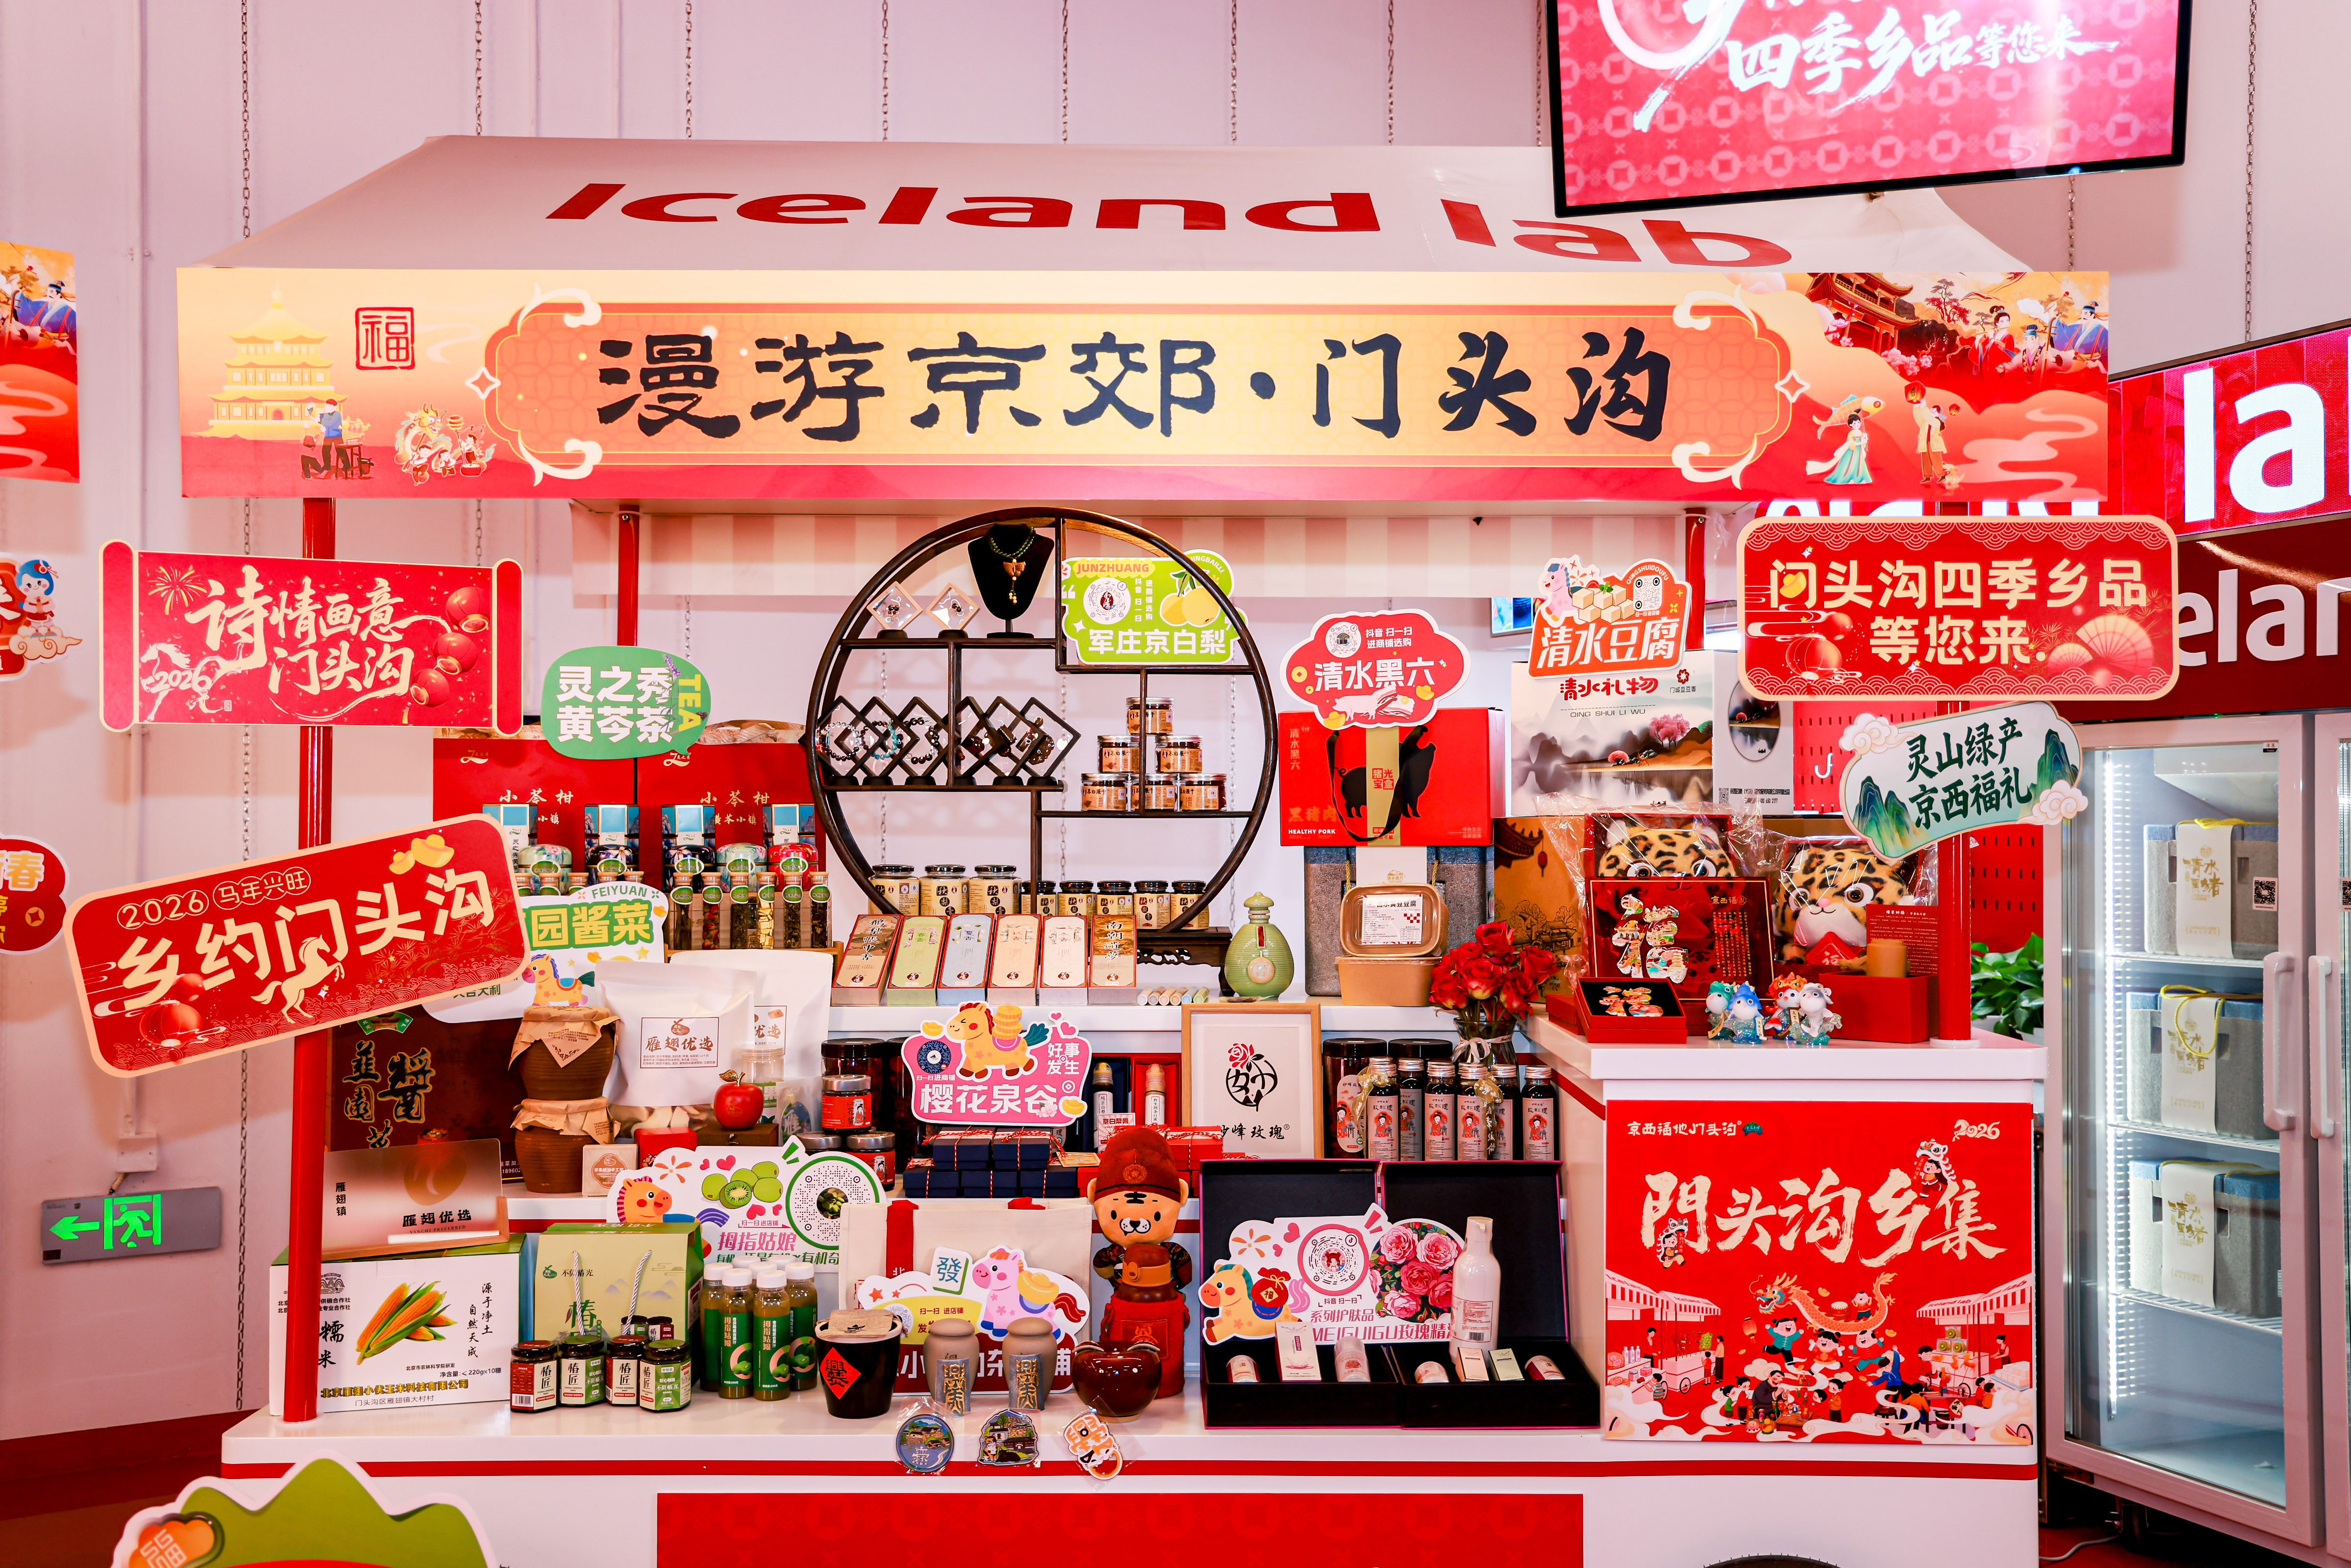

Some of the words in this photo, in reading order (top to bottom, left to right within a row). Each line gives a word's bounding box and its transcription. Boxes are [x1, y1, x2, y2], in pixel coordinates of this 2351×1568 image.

[1724, 11, 2120, 114] 四季乡品等您来
[545, 183, 1381, 232] Iceland
[1440, 198, 1793, 268] lab
[597, 327, 1671, 442] 漫游京郊·门头沟
[2183, 339, 2351, 523] la
[1077, 563, 1149, 574] JUNZHUANG
[1626, 565, 1669, 585] QINGSHUIDOUFU
[1770, 556, 2147, 610] 门头沟四季乡品
[185, 564, 404, 670] 诗情画意
[1366, 629, 1383, 638] 抖音
[1386, 627, 1413, 636] 扫一扫
[1089, 628, 1225, 655] 军庄京白梨
[1367, 638, 1413, 649] 进商铺选购
[1536, 616, 1679, 669] 清水豆腐
[155, 667, 213, 691] 2026
[268, 640, 414, 695] 门头沟
[1314, 656, 1435, 691] 清水黑六
[557, 665, 673, 703] 灵之秀
[1560, 677, 1658, 701] 清水礼物
[678, 674, 701, 733] TEA
[557, 705, 674, 744] 黄芩茶
[1290, 728, 1300, 770] 清水黑六
[1905, 717, 2023, 783] 灵山绿产
[1909, 767, 2032, 830] 京西福礼
[0, 853, 42, 889] 春
[120, 891, 206, 929] 2026
[217, 871, 309, 907] 马年兴旺
[592, 885, 647, 899] FEIYUAN
[117, 868, 495, 1011] 乡约门头沟
[523, 903, 650, 948] 园酱菜
[645, 1036, 714, 1052] 雁翅优选
[1047, 1042, 1080, 1058] 好事
[1046, 1059, 1080, 1075] 发生
[920, 1083, 1057, 1114] 樱花泉谷
[1627, 1121, 1737, 1137] 京西福地门头沟
[1952, 1119, 2000, 1141] 2026
[336, 1182, 347, 1217] 雁翅镇
[402, 1209, 472, 1228] 雁翅优选
[717, 1232, 797, 1251] 拇指姑娘
[936, 1257, 963, 1283] 發
[481, 1282, 494, 1335] 源于净土
[1264, 1290, 1274, 1300] 福
[467, 1304, 480, 1358] 自然天成
[1310, 1308, 1374, 1323] 系列护肤品
[318, 1320, 345, 1369] 糯米
[763, 1320, 771, 1351] 拇指姑娘
[1313, 1323, 1453, 1342] MEIGUIGU玫瑰精
[406, 1362, 456, 1372] 北京市农林科学院研发
[568, 1362, 579, 1385] 椿匠
[619, 1362, 631, 1385] 椿匠
[320, 1378, 469, 1399] 北京雁翅小优玉米科技有限公司
[355, 1394, 434, 1407] 门头沟区雁翅镇大村村
